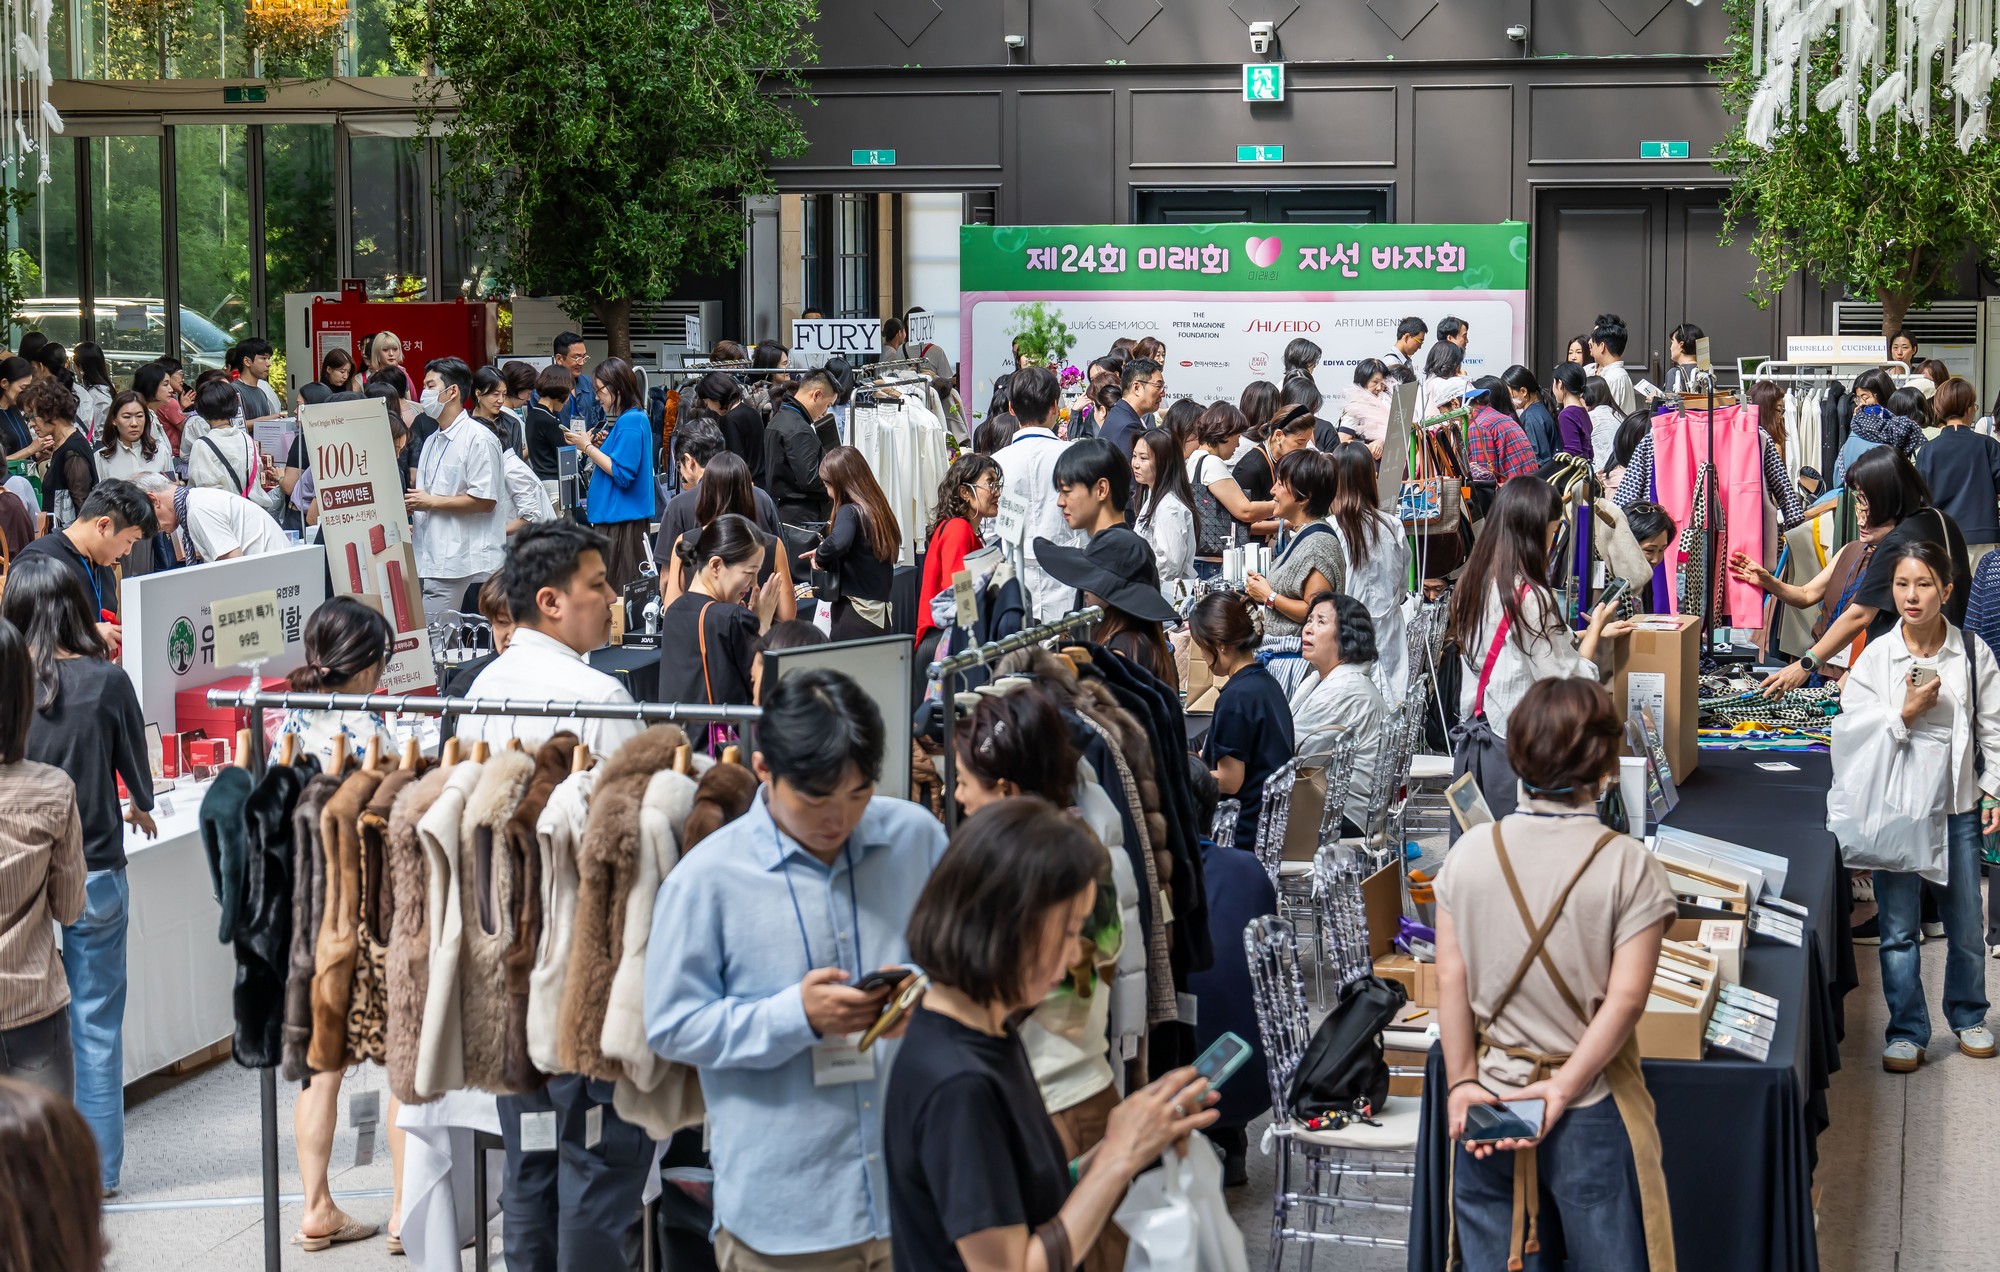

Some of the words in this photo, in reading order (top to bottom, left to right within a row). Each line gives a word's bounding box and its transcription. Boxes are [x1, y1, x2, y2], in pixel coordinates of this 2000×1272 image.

[1026, 242, 1126, 273] 제24회
[1138, 242, 1229, 274] 미래회
[1299, 241, 1360, 278] 자선
[1371, 241, 1466, 273] 바자회
[1247, 270, 1279, 281] 미래회
[909, 315, 935, 343] FURY
[1098, 320, 1160, 330] SAEMMOOL
[1241, 319, 1321, 333] SHISEIDO
[1335, 318, 1374, 328] ARTIUM
[793, 323, 880, 351] FURY
[1788, 344, 1834, 352] BRUNELLO
[1841, 344, 1886, 352] CUCINELLI
[330, 415, 345, 426] wise
[317, 441, 368, 480] 100년
[334, 487, 355, 504] 유한이
[355, 486, 373, 502] 만든,
[325, 512, 341, 526] 최초의
[341, 513, 355, 524] 50+
[355, 508, 378, 522] 스킨케어
[218, 607, 255, 628] 모피조끼
[255, 602, 275, 619] 특가
